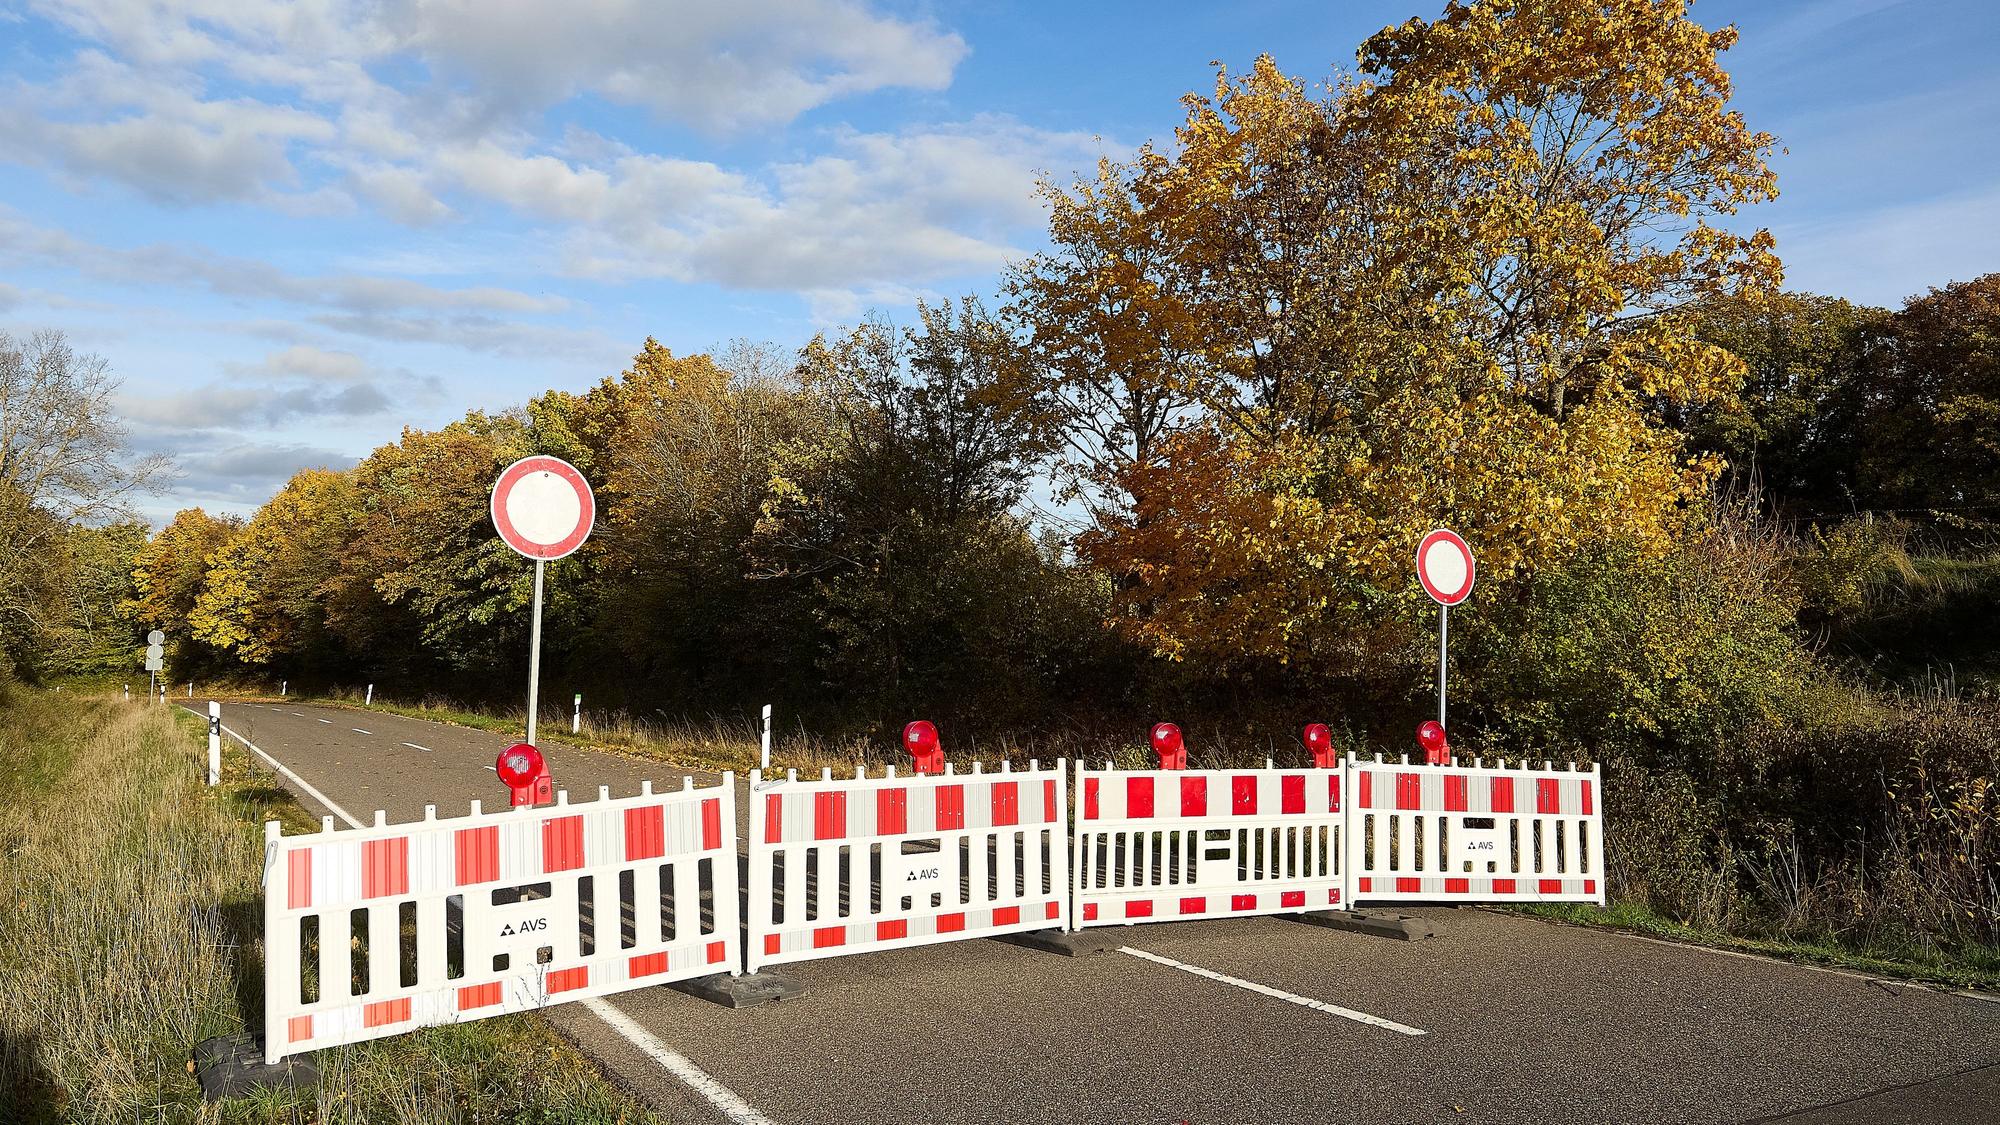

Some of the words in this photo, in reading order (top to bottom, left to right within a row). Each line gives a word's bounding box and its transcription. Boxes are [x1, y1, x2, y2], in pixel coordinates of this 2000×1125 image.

[1478, 841, 1494, 850] AVS
[920, 868, 939, 880] AVS
[519, 918, 547, 933] AVS
